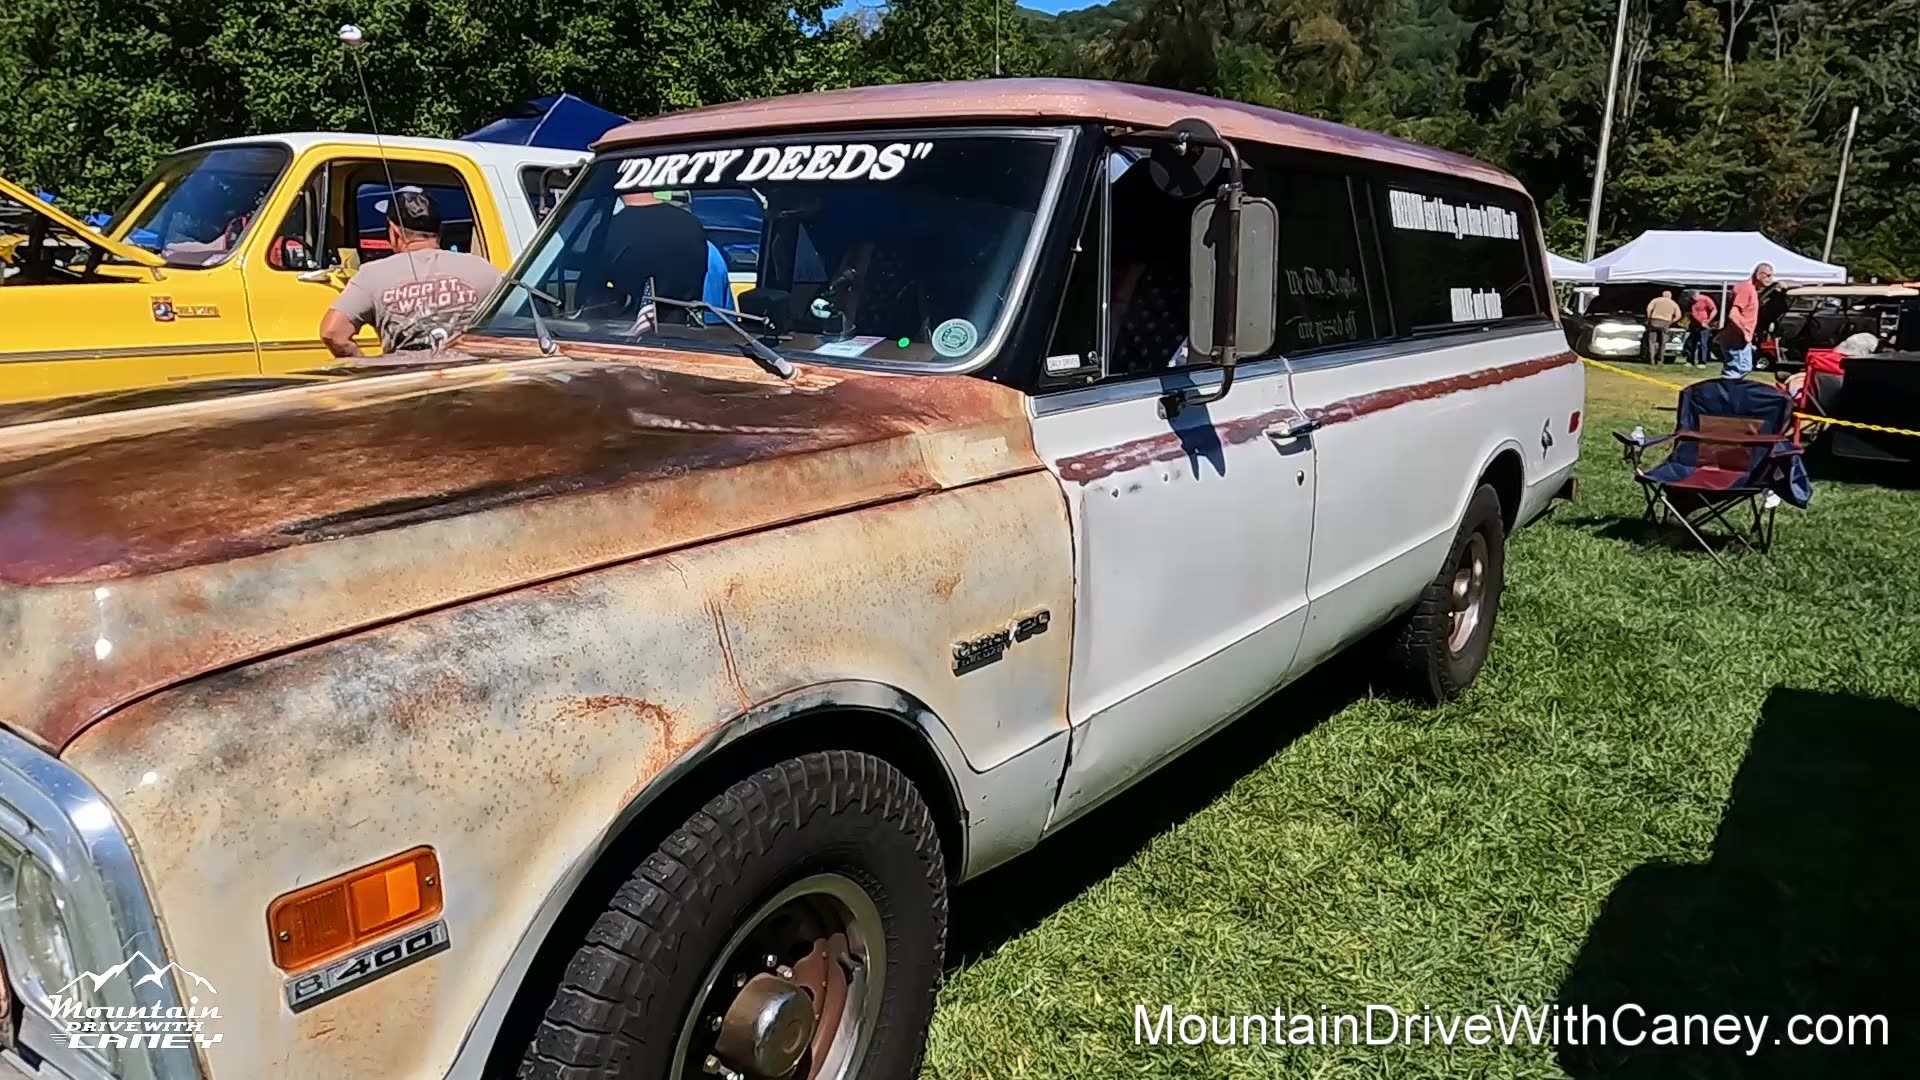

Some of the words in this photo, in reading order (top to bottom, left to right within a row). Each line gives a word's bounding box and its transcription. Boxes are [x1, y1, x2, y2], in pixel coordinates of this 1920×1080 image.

[614, 149, 744, 189] "DIRTY
[736, 142, 933, 182] DEEDS"
[383, 283, 433, 302] CHOP
[337, 930, 433, 980] 400
